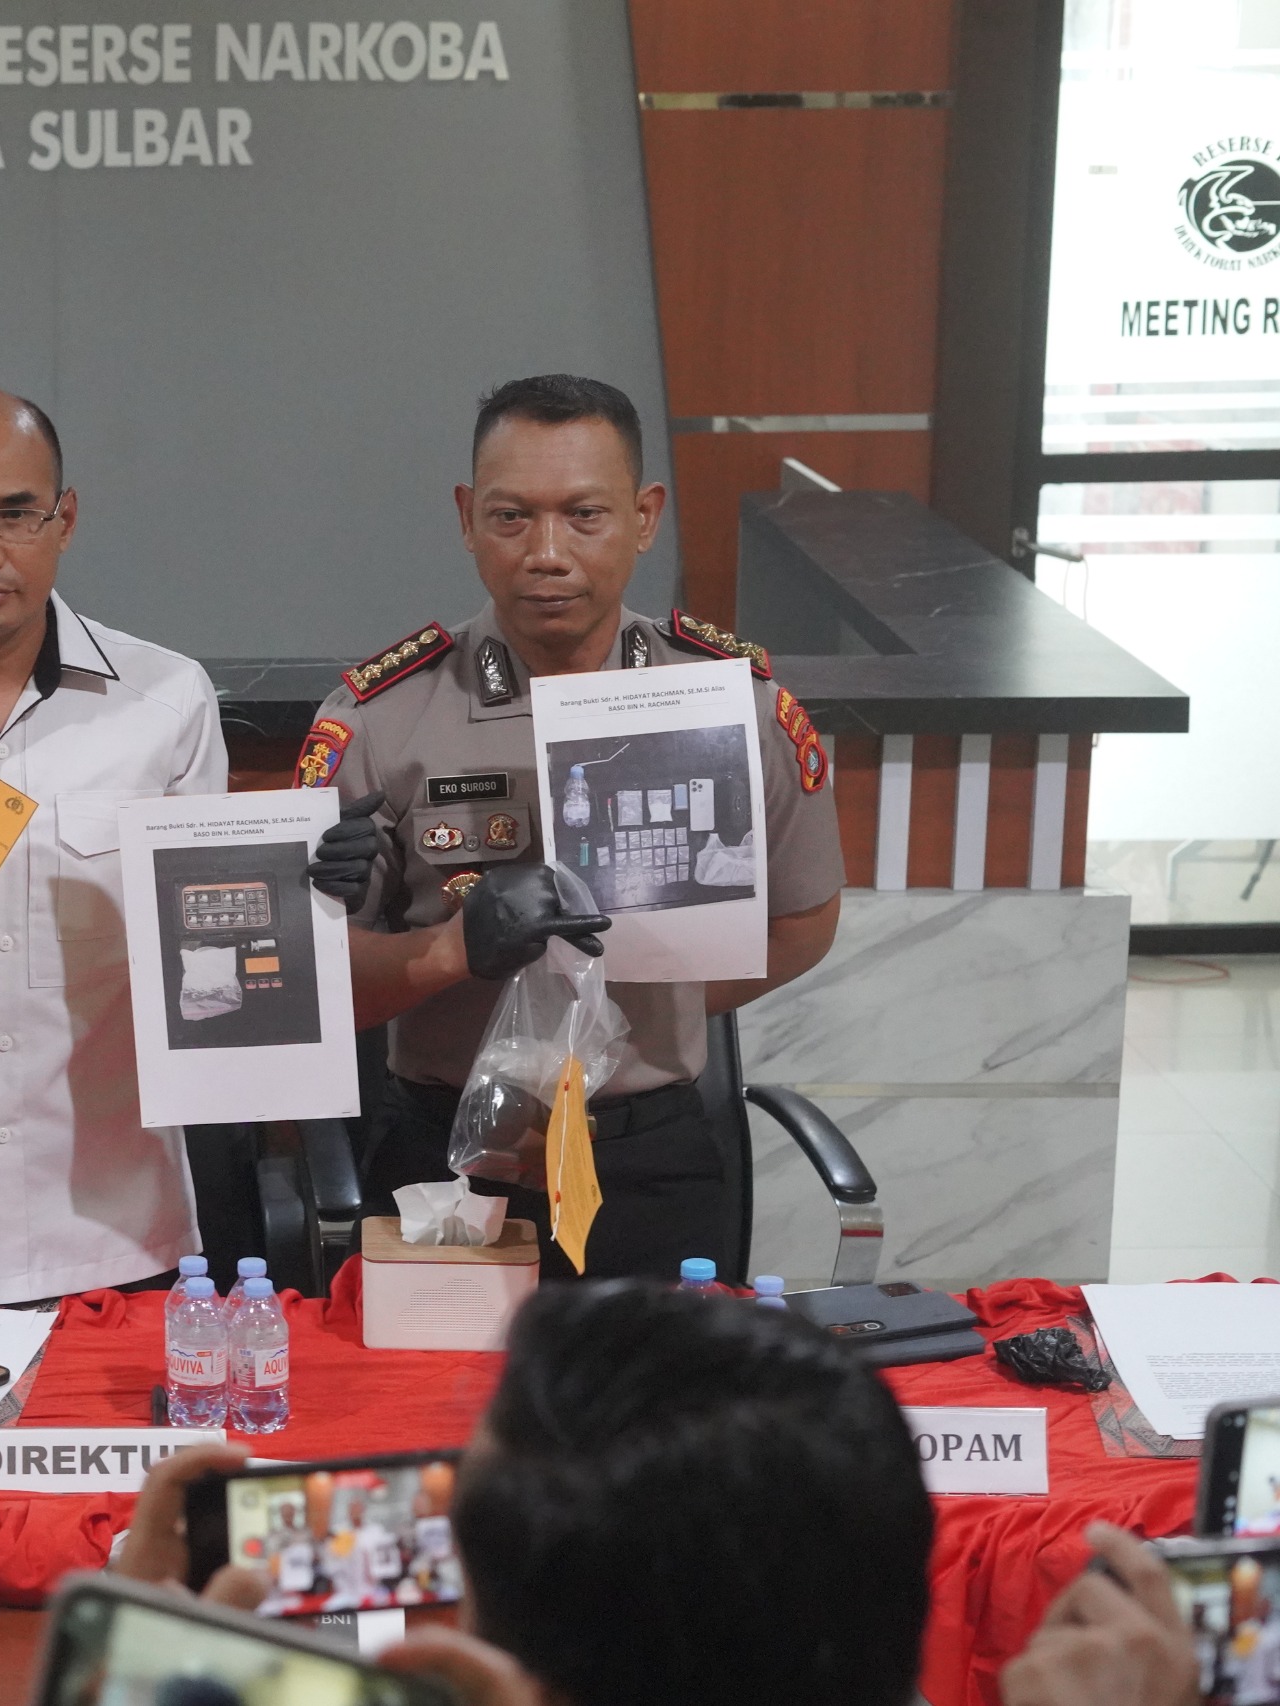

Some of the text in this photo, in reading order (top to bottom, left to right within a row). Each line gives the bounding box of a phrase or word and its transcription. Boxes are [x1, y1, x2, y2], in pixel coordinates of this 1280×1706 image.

[214, 20, 510, 84] NARKOBA
[28, 107, 253, 170] SULBAR
[1121, 298, 1251, 337] MEETING
[623, 692, 650, 701] HIDAYAT
[652, 689, 687, 698] RACHMAN,
[608, 704, 626, 712] BASO
[627, 703, 639, 711] BIN
[648, 699, 681, 708] RACHMAN
[439, 781, 497, 794] EKO SUROSO
[207, 820, 235, 828] HIDAYAT
[236, 818, 270, 826] RACHMAN,
[321, 1614, 351, 1625] BNI
